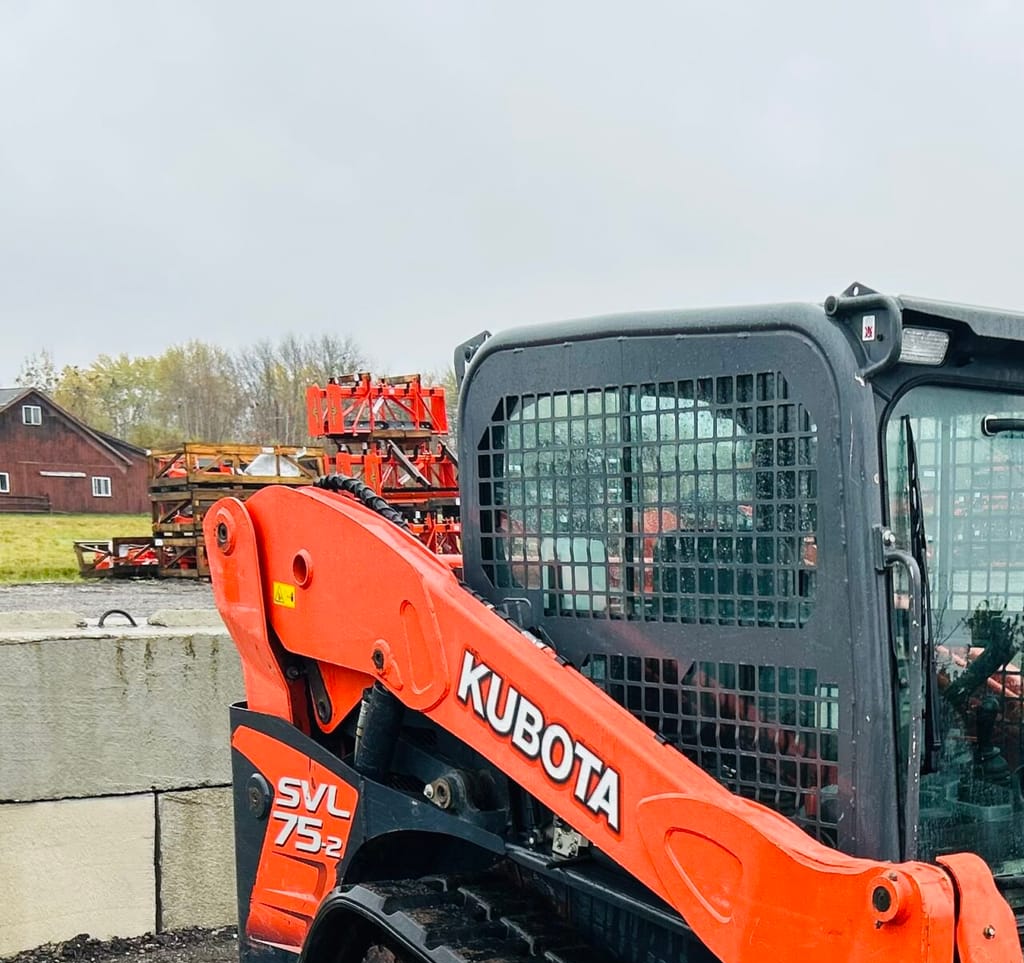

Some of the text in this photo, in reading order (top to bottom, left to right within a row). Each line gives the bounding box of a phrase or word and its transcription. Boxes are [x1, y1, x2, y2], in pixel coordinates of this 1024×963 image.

[457, 649, 620, 832] KUBOTA
[276, 776, 351, 819] SVL
[272, 810, 343, 859] 75-2
